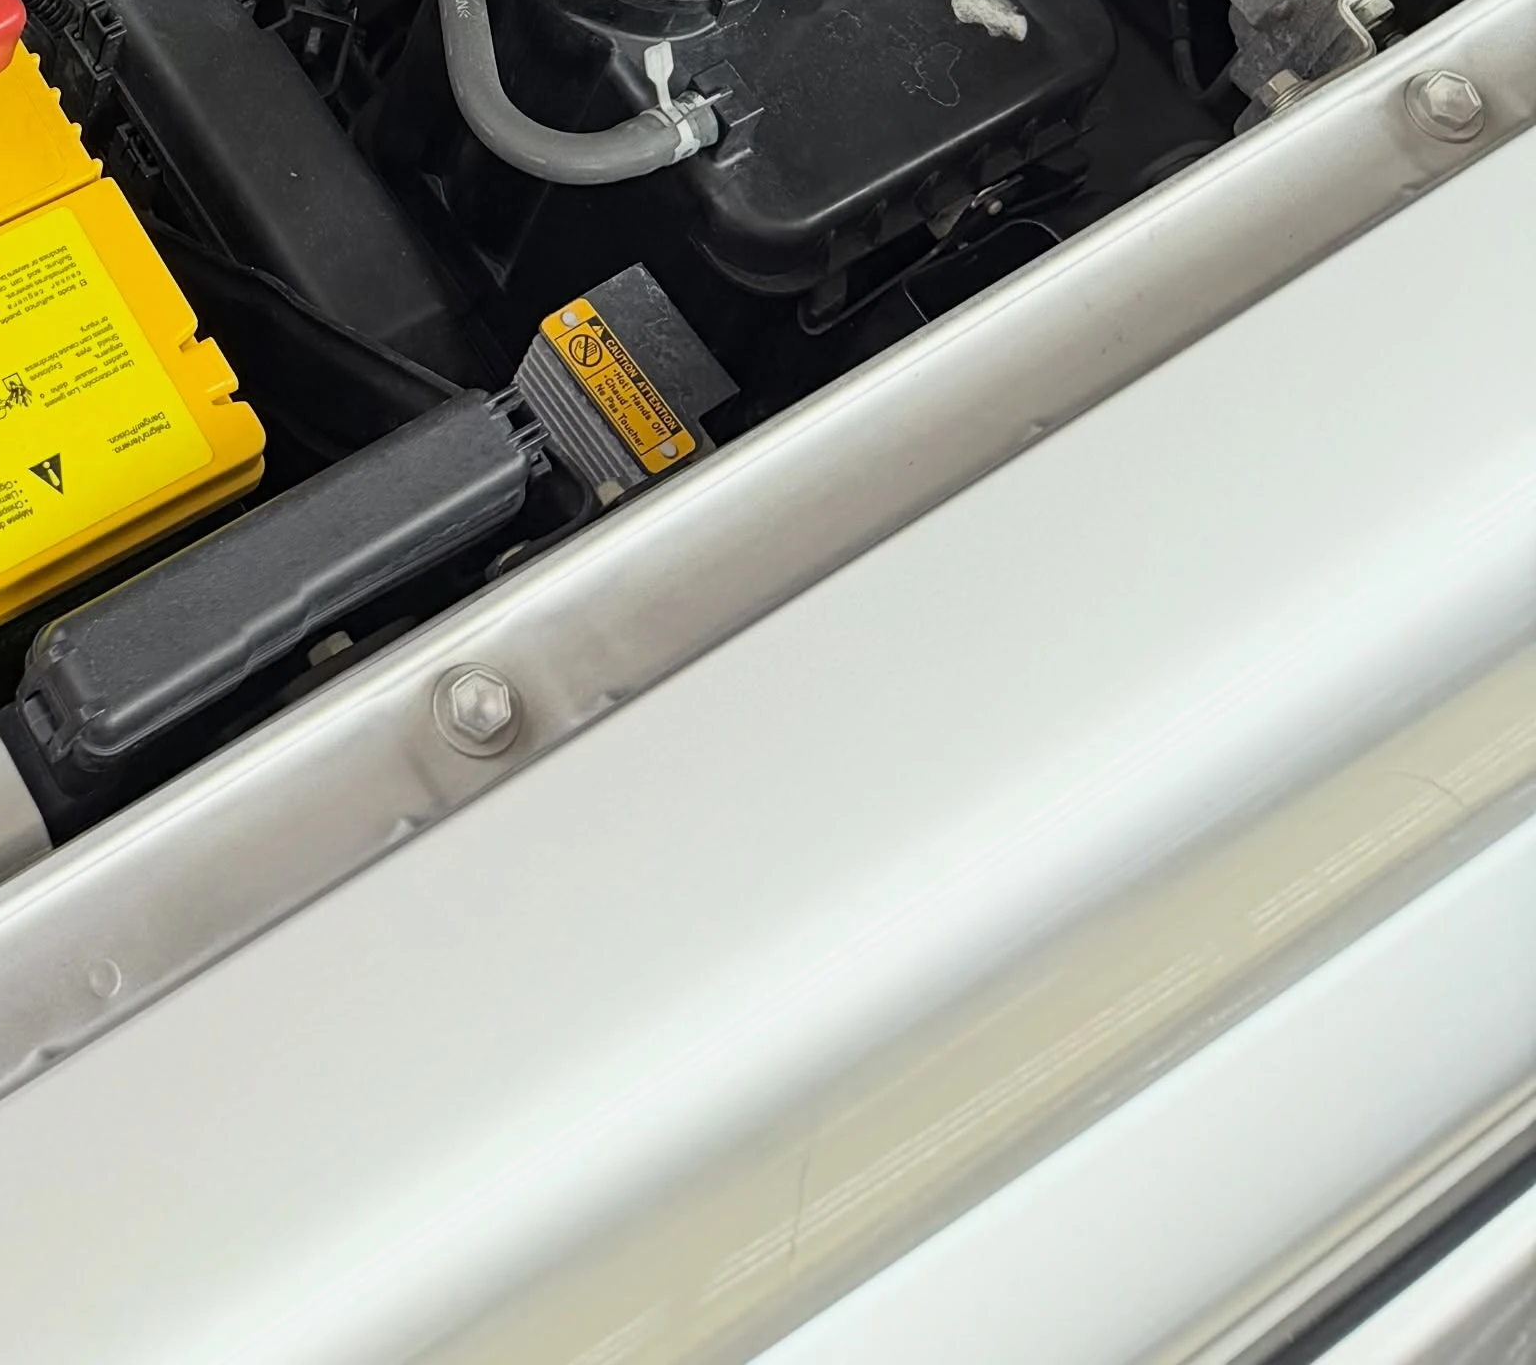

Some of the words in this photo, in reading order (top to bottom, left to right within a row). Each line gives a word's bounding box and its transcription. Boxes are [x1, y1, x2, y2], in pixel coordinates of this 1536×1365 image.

[594, 382, 608, 397] Ne
[603, 395, 621, 415] Pas
[617, 412, 645, 448] Toucher
[604, 338, 638, 379] CAUTION
[636, 379, 677, 431] ATTENTION
[629, 392, 653, 421] Hands
[650, 419, 667, 437] Off
